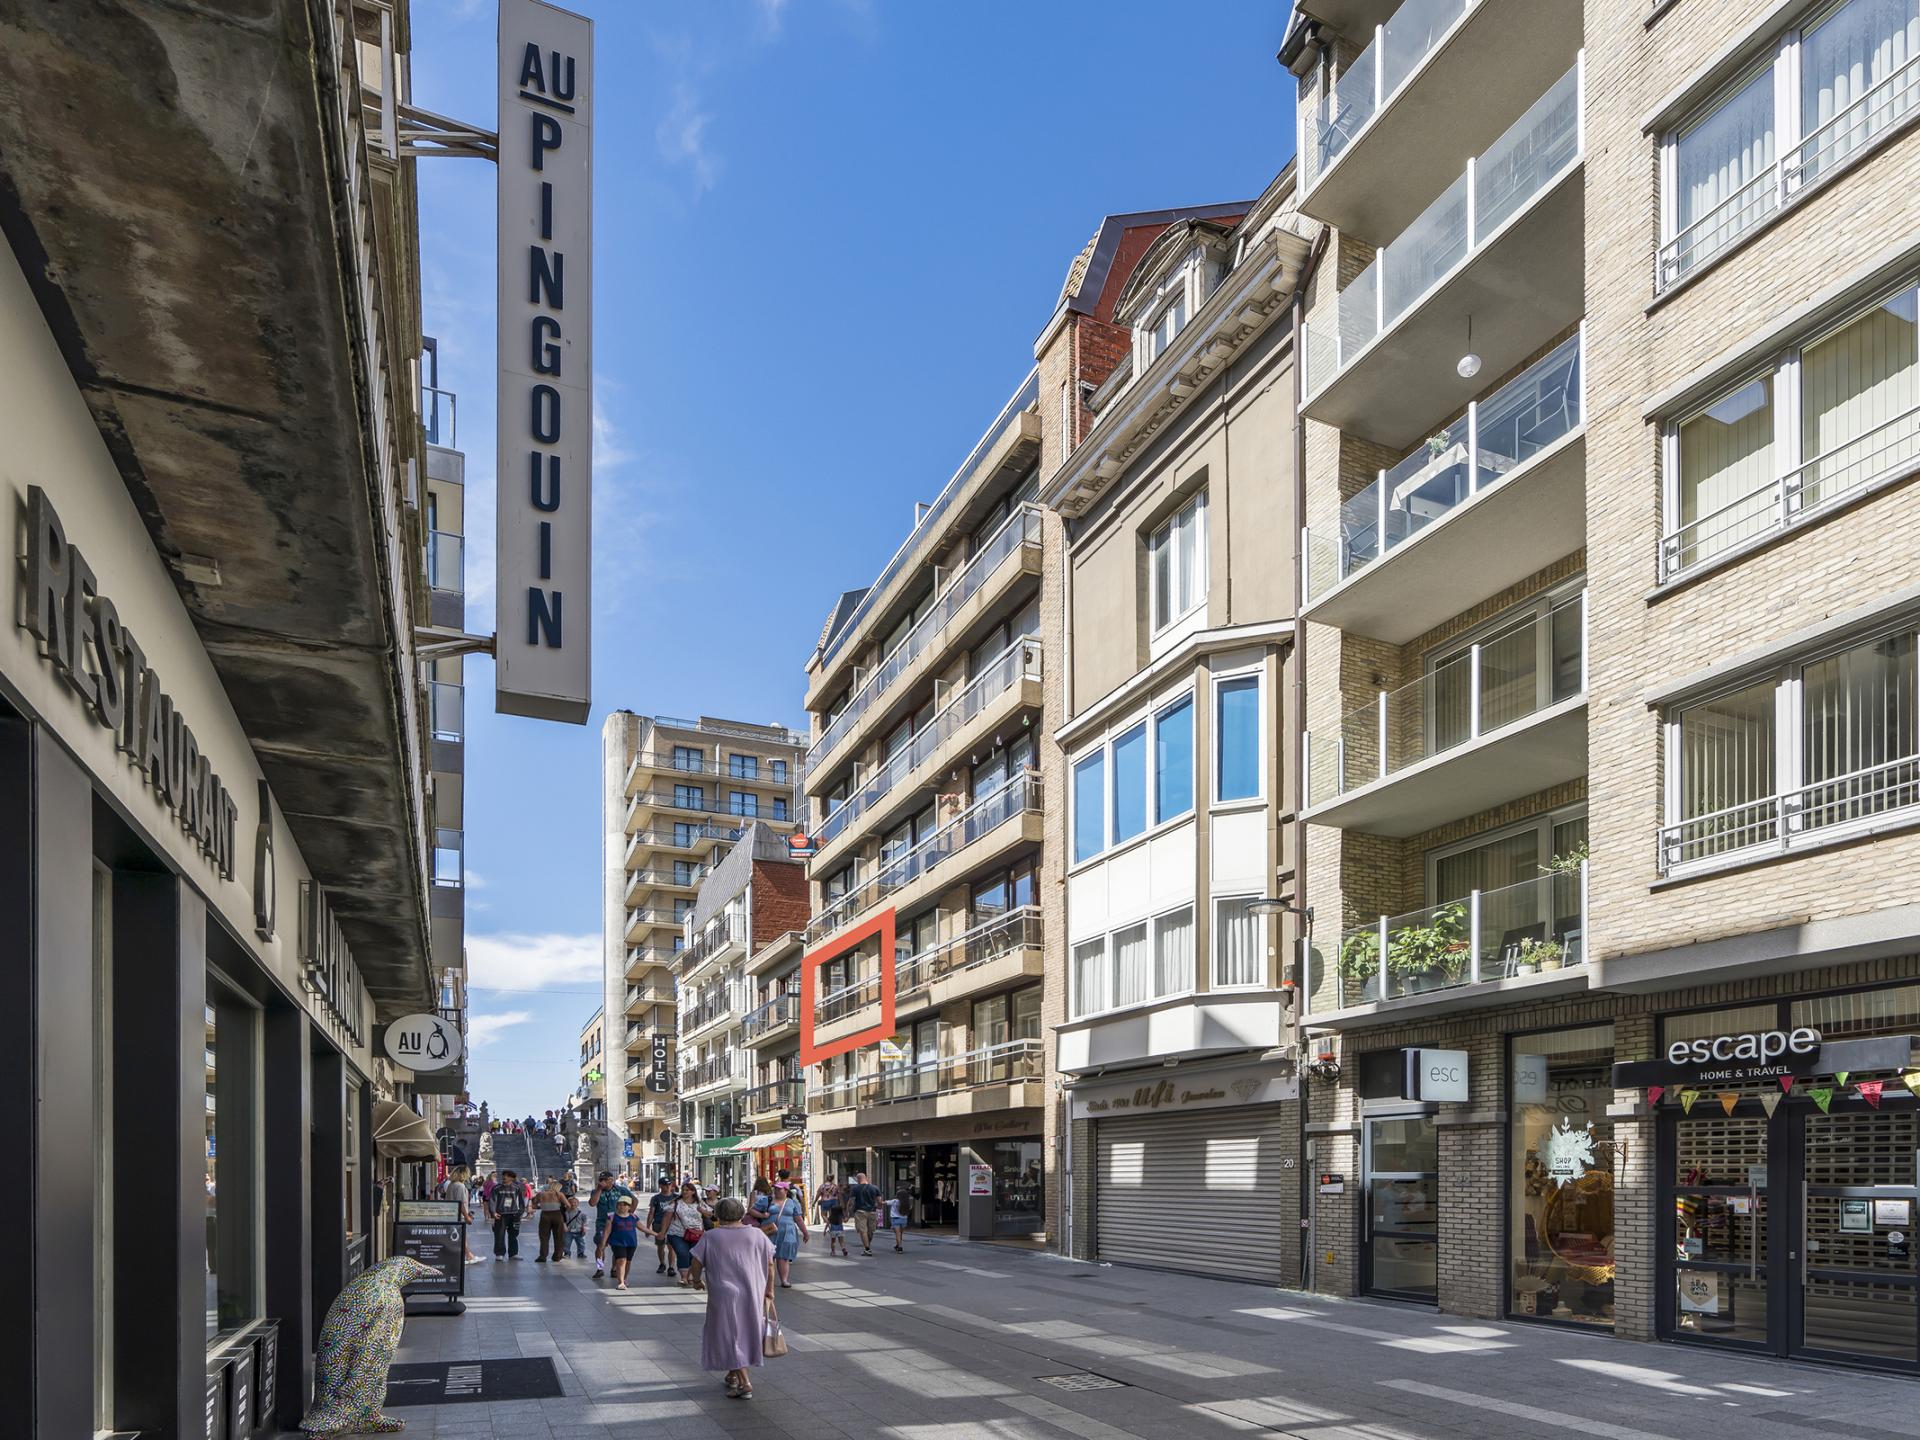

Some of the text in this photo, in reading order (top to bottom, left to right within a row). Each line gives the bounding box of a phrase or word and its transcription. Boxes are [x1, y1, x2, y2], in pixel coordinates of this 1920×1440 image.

[520, 41, 576, 102] AU
[528, 111, 565, 649] PINGOUIN
[26, 484, 239, 882] RESTAURANT
[398, 1031, 421, 1050] AU
[1667, 1027, 1817, 1066] escape
[654, 1037, 667, 1093] HOTEL
[1430, 1066, 1460, 1083] esc
[1699, 1065, 1792, 1081] HOME & TRAVEL
[1284, 1159, 1294, 1168] 20
